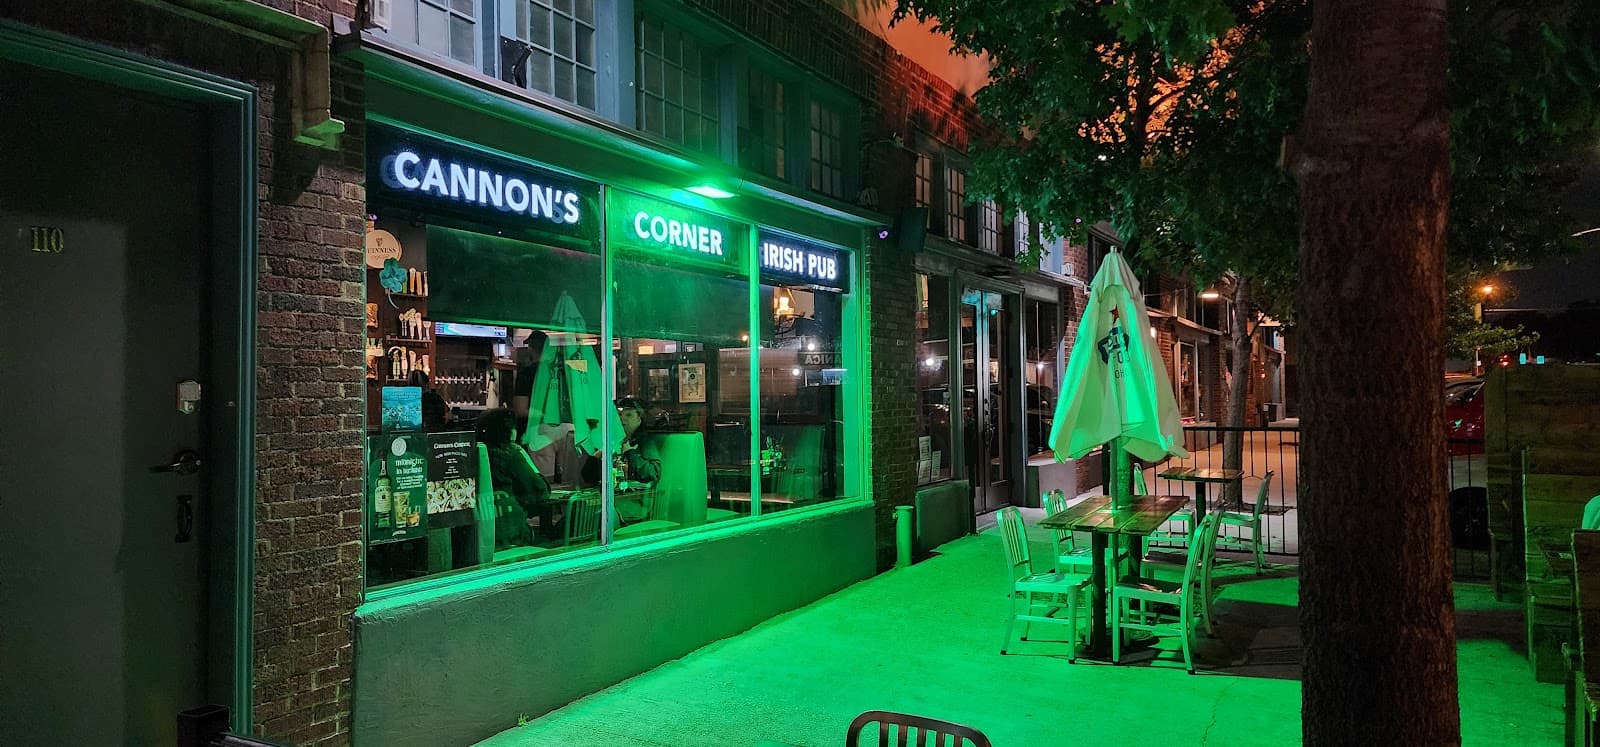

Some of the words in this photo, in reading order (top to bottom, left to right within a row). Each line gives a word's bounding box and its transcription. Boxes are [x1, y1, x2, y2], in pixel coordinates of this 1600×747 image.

[393, 151, 580, 224] CANNON'S
[31, 226, 64, 254] 110
[634, 210, 724, 256] CORNER
[763, 242, 804, 275] IRISH
[808, 253, 836, 280] PUB
